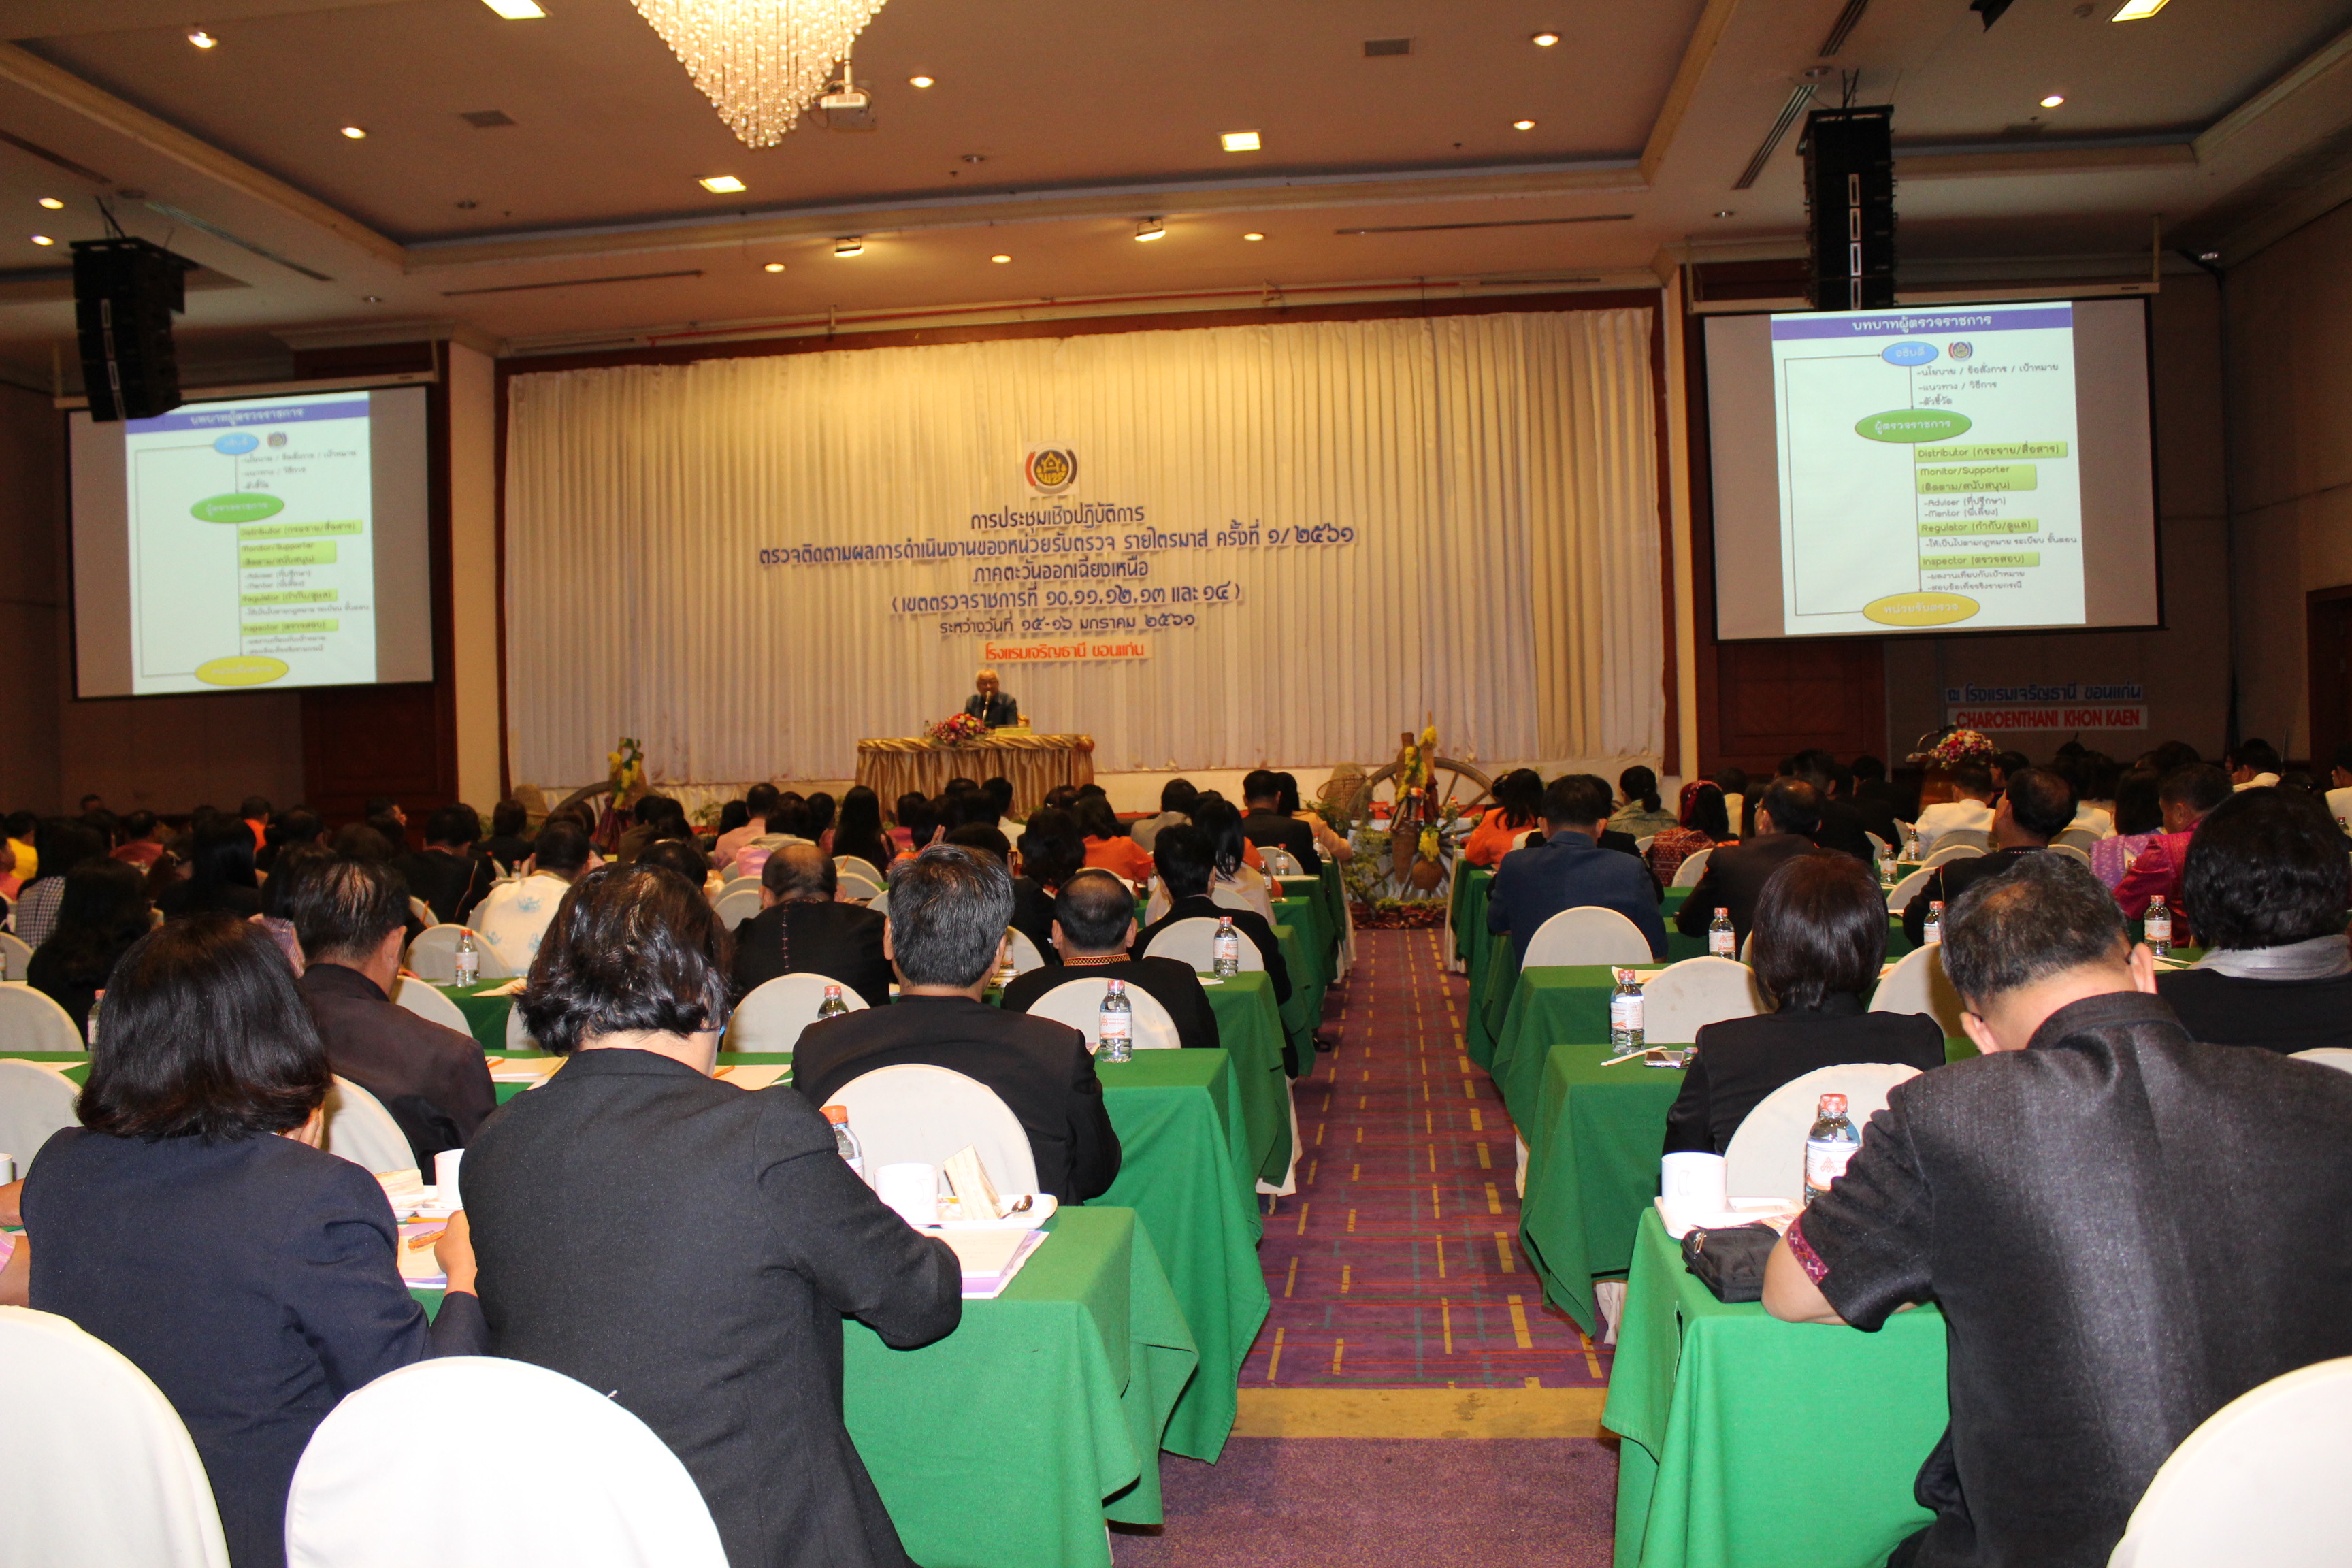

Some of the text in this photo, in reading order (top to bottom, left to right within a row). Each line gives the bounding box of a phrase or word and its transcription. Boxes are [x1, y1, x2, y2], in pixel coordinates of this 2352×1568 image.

[1852, 315, 1992, 333] บทบาทผู้ตรวจราชการ
[1875, 420, 1951, 435] ผู้ตรวจราชการ
[1918, 448, 1969, 457] Distributor
[1920, 465, 2010, 476] Monitor/Supporter
[971, 502, 1145, 534] การประชุมเชิงปฏิบัติการ
[1921, 523, 1967, 534] Regulator
[760, 531, 1115, 564] ตรวจติดตามผลการดำเนินงานของหน่วยรับตรวจ
[1124, 527, 1208, 550] รายไตรมาส
[1217, 519, 1260, 546] ครั้งที่
[973, 555, 1148, 583] ภาคตะวันออกเฉียงเหนือ
[1923, 557, 1967, 567] Inspector
[1172, 587, 1198, 602] และ
[940, 611, 1195, 634] ระหว่างวันที่ ๑๕-๑๖ มกราคม ๒๕๖๑
[985, 641, 1144, 660] โรงแรมเจริญธานี ขอนแก่น
[1965, 681, 2078, 702] โรงแรมเจริญธานี
[2085, 681, 2141, 700] ขอนแก่น
[1956, 709, 2140, 728] CHAROENTHANI KHON KAEN
